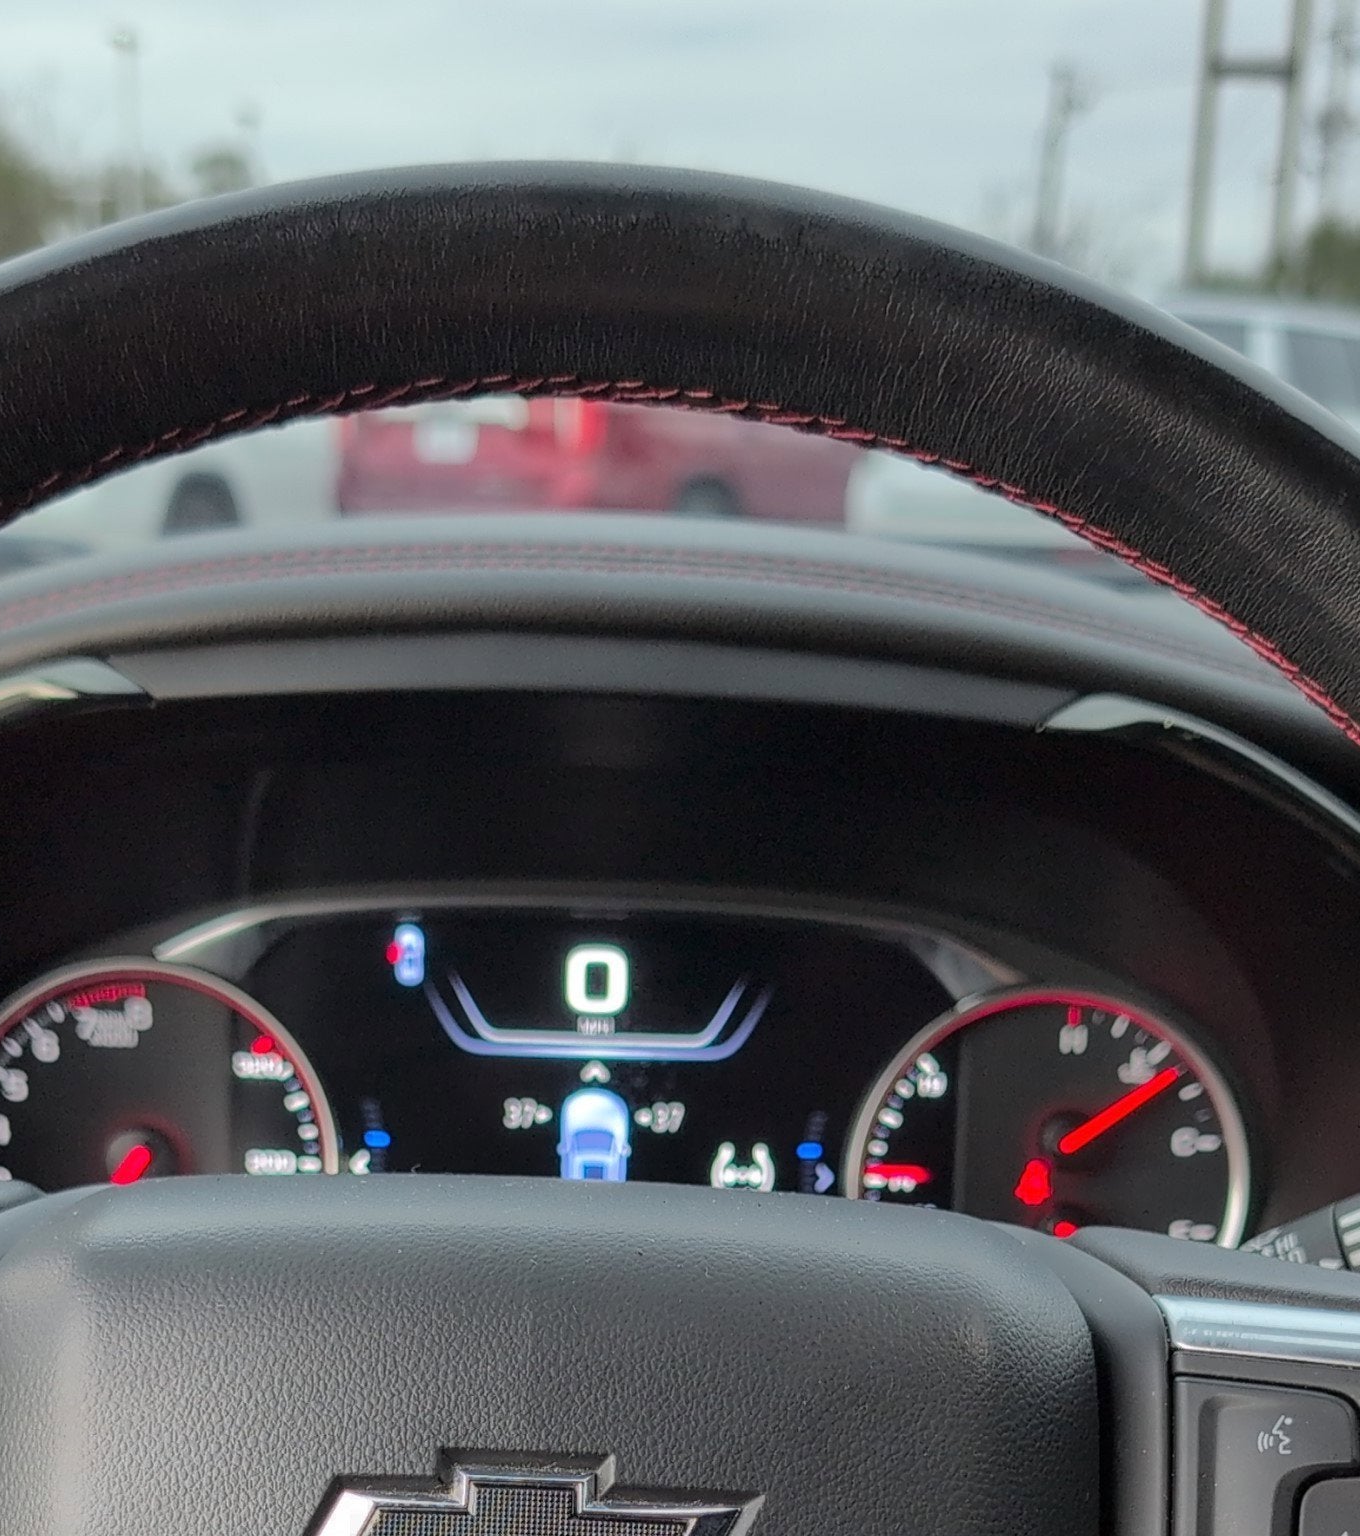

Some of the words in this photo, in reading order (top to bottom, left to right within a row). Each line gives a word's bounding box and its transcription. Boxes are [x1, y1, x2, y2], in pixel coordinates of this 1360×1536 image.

[566, 945, 629, 1015] 0
[503, 1097, 538, 1129] 37
[651, 1101, 686, 1133] 37
